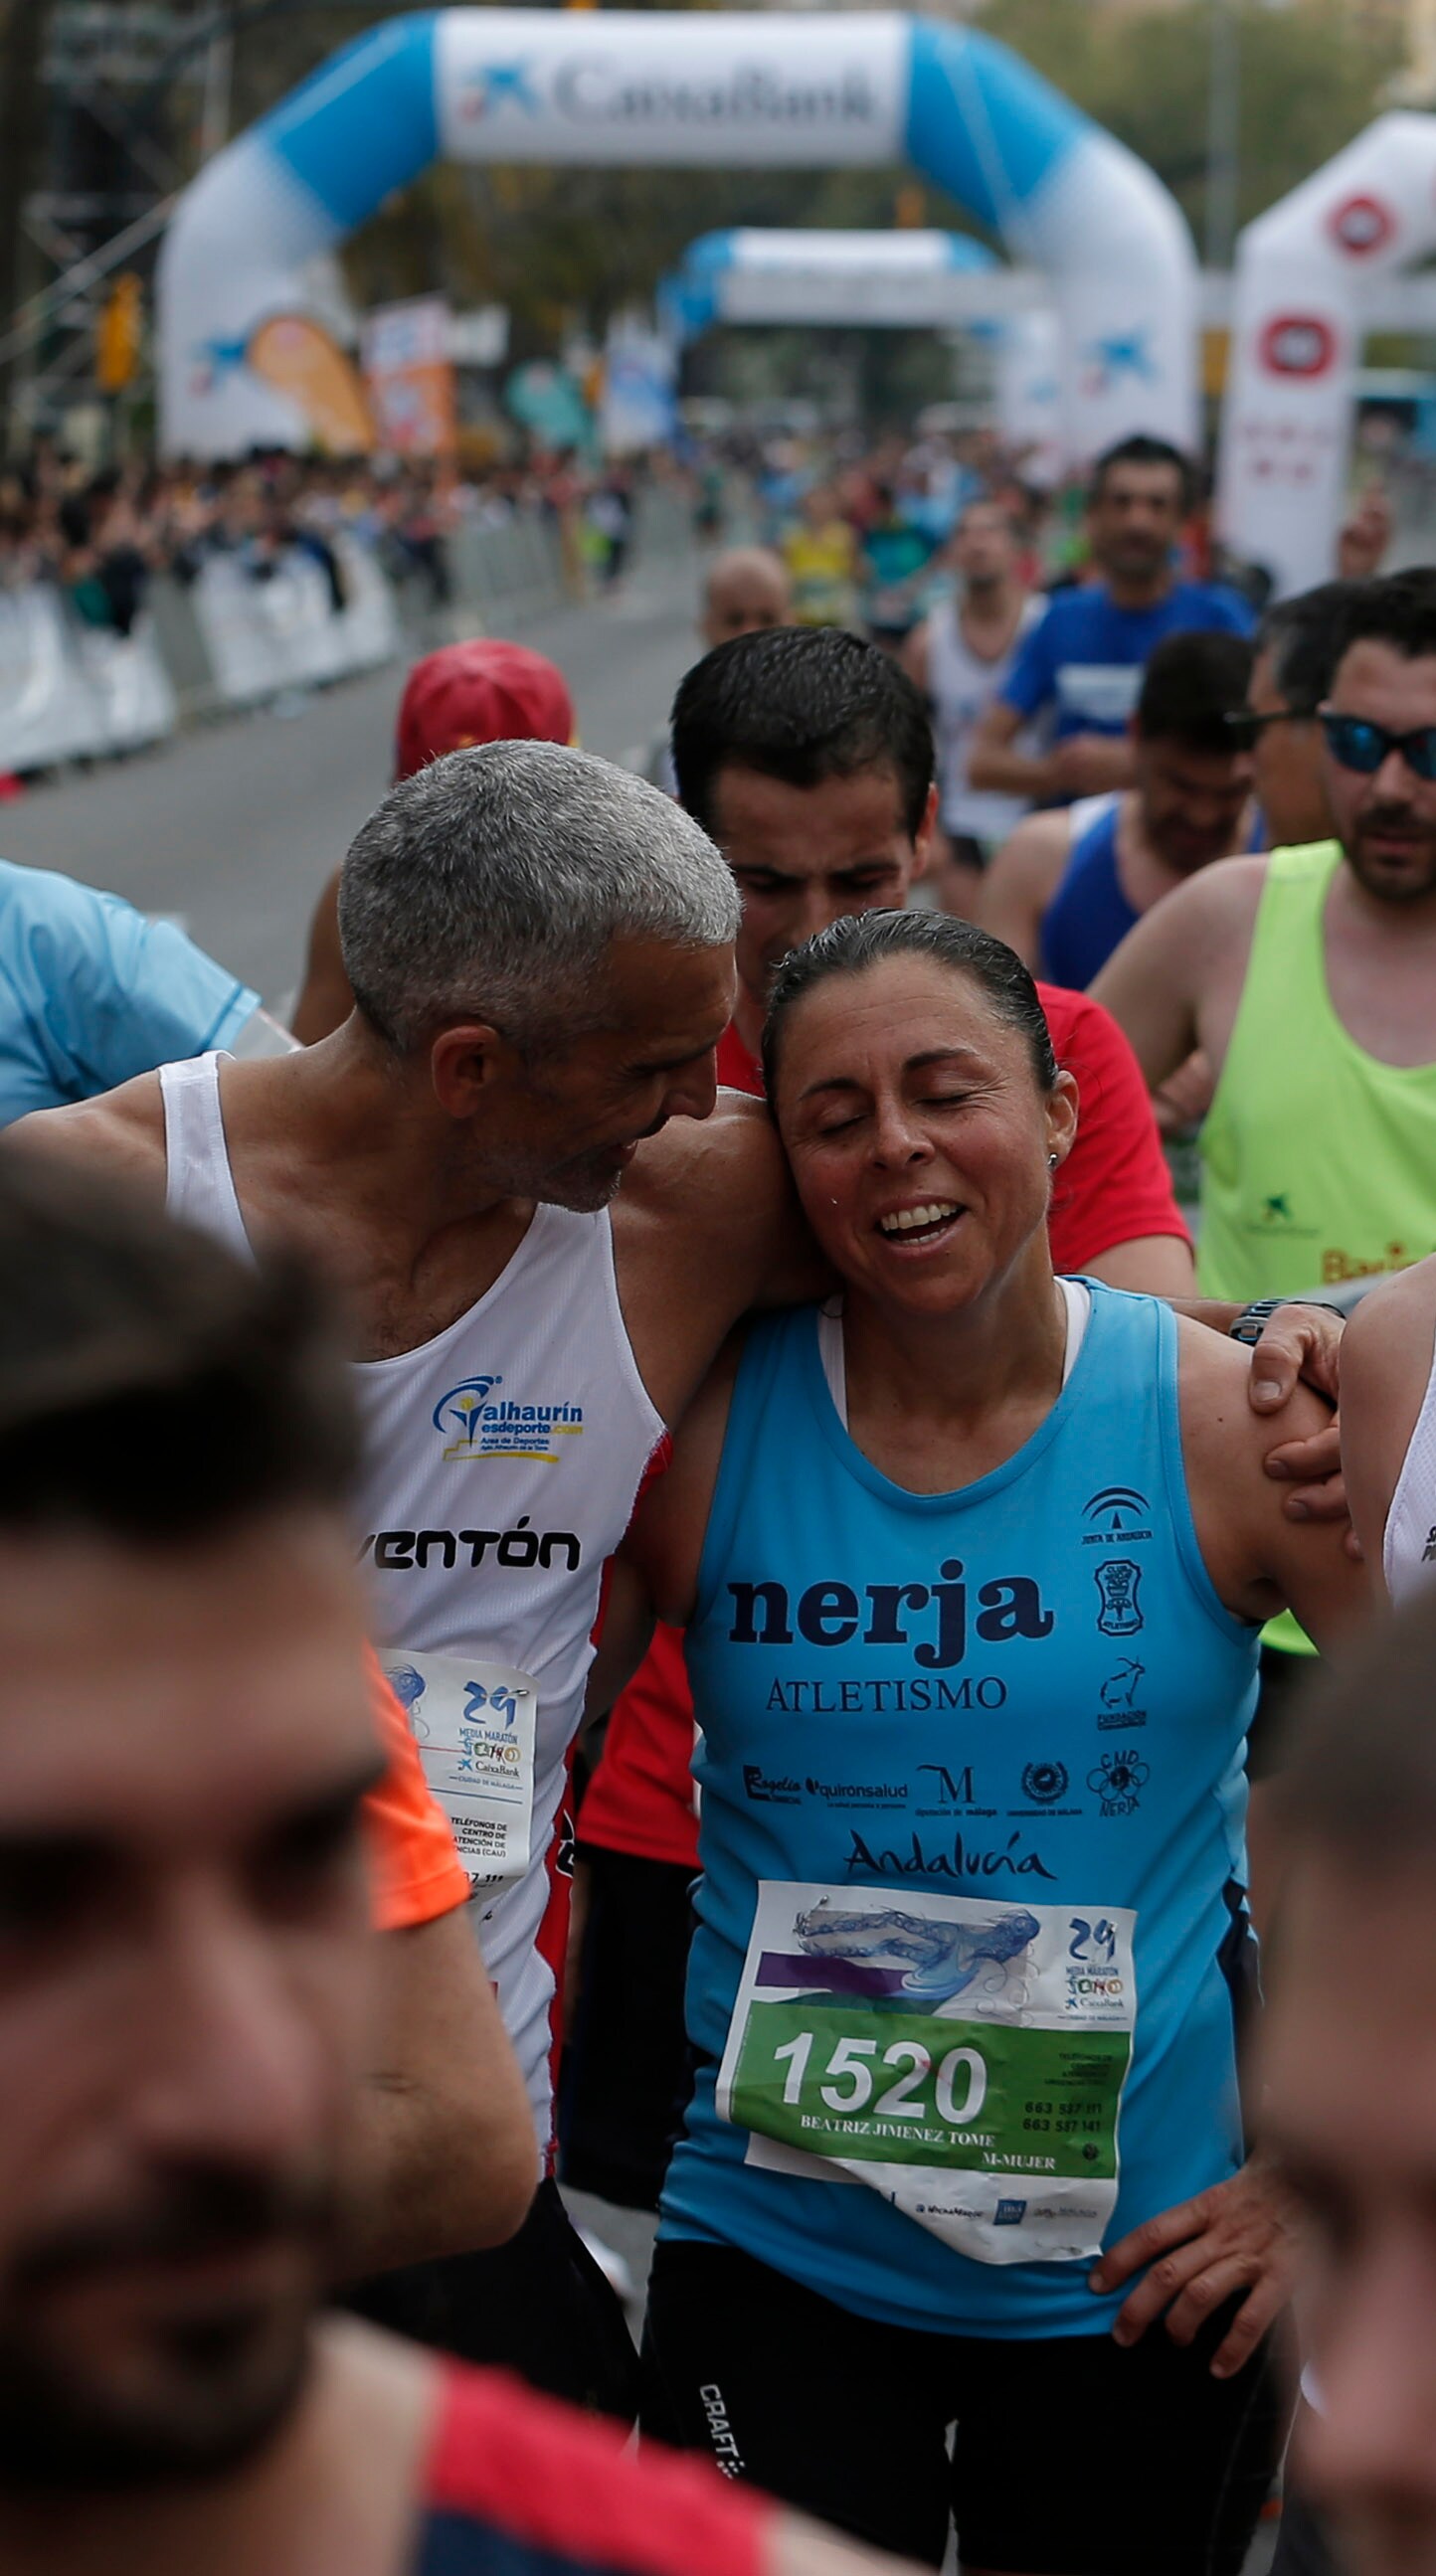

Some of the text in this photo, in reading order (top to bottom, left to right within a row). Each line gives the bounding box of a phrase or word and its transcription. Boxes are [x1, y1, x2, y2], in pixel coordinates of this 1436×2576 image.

[727, 1558, 1054, 1669] nerja
[463, 1680, 517, 1731] 29
[766, 1676, 1007, 1712] ATLETISMO
[459, 1727, 518, 1744] MEDIA MARATÓN
[475, 1761, 519, 1778] CaixaBank
[450, 1816, 495, 1830] TELÉFONOS
[461, 1827, 494, 1838] CENTRO
[482, 1848, 506, 1858] (CAU)
[843, 1828, 1058, 1880] Andalucía
[1068, 1917, 1116, 1963] 29
[773, 2032, 987, 2125] 1520
[1025, 2101, 1052, 2115] 663
[800, 2114, 995, 2147] BEATRIZ JIMENEZ TOME
[1022, 2118, 1050, 2131] 663
[983, 2151, 1056, 2170] M-MUJER
[699, 2384, 740, 2459] CRAFT
